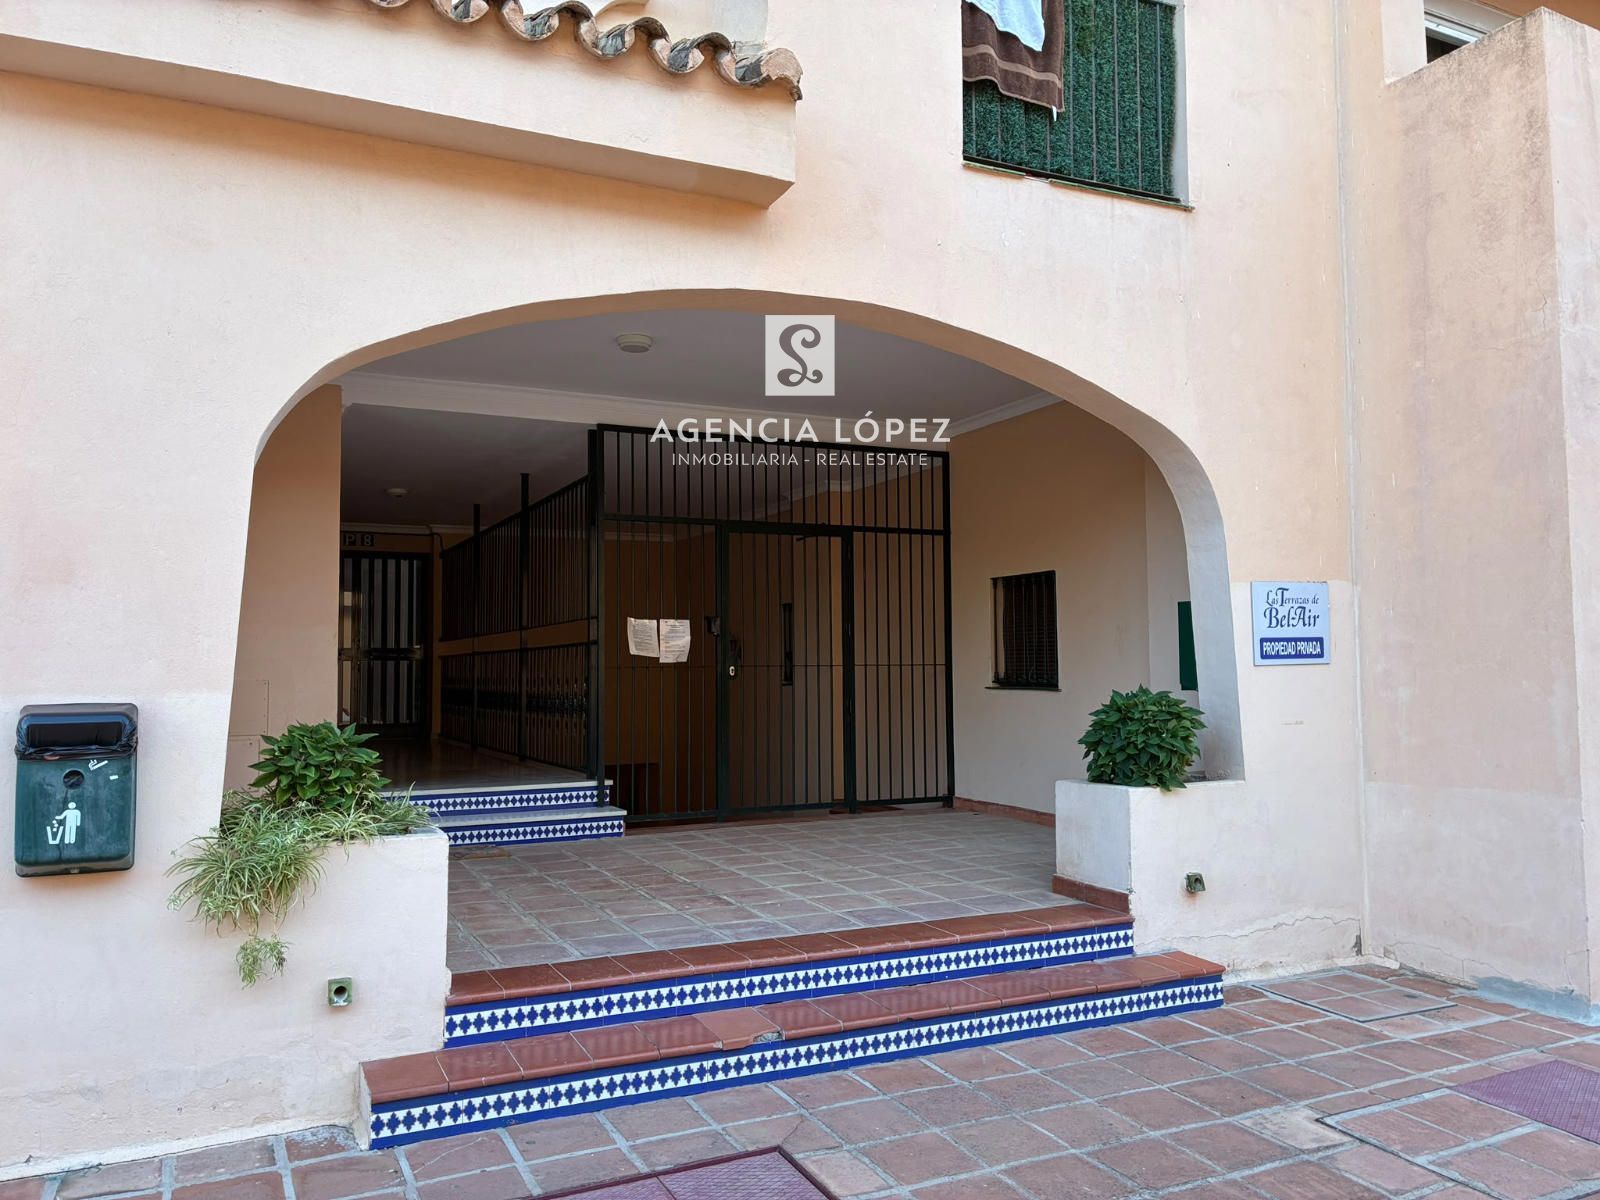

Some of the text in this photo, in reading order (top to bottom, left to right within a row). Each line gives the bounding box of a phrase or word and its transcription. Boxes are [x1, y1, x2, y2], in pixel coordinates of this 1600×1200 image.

[1266, 587, 1319, 606] Las Terrazas de
[1264, 606, 1320, 628] Bel-Air
[1263, 641, 1321, 655] PROPIEDAD PRIVADA
